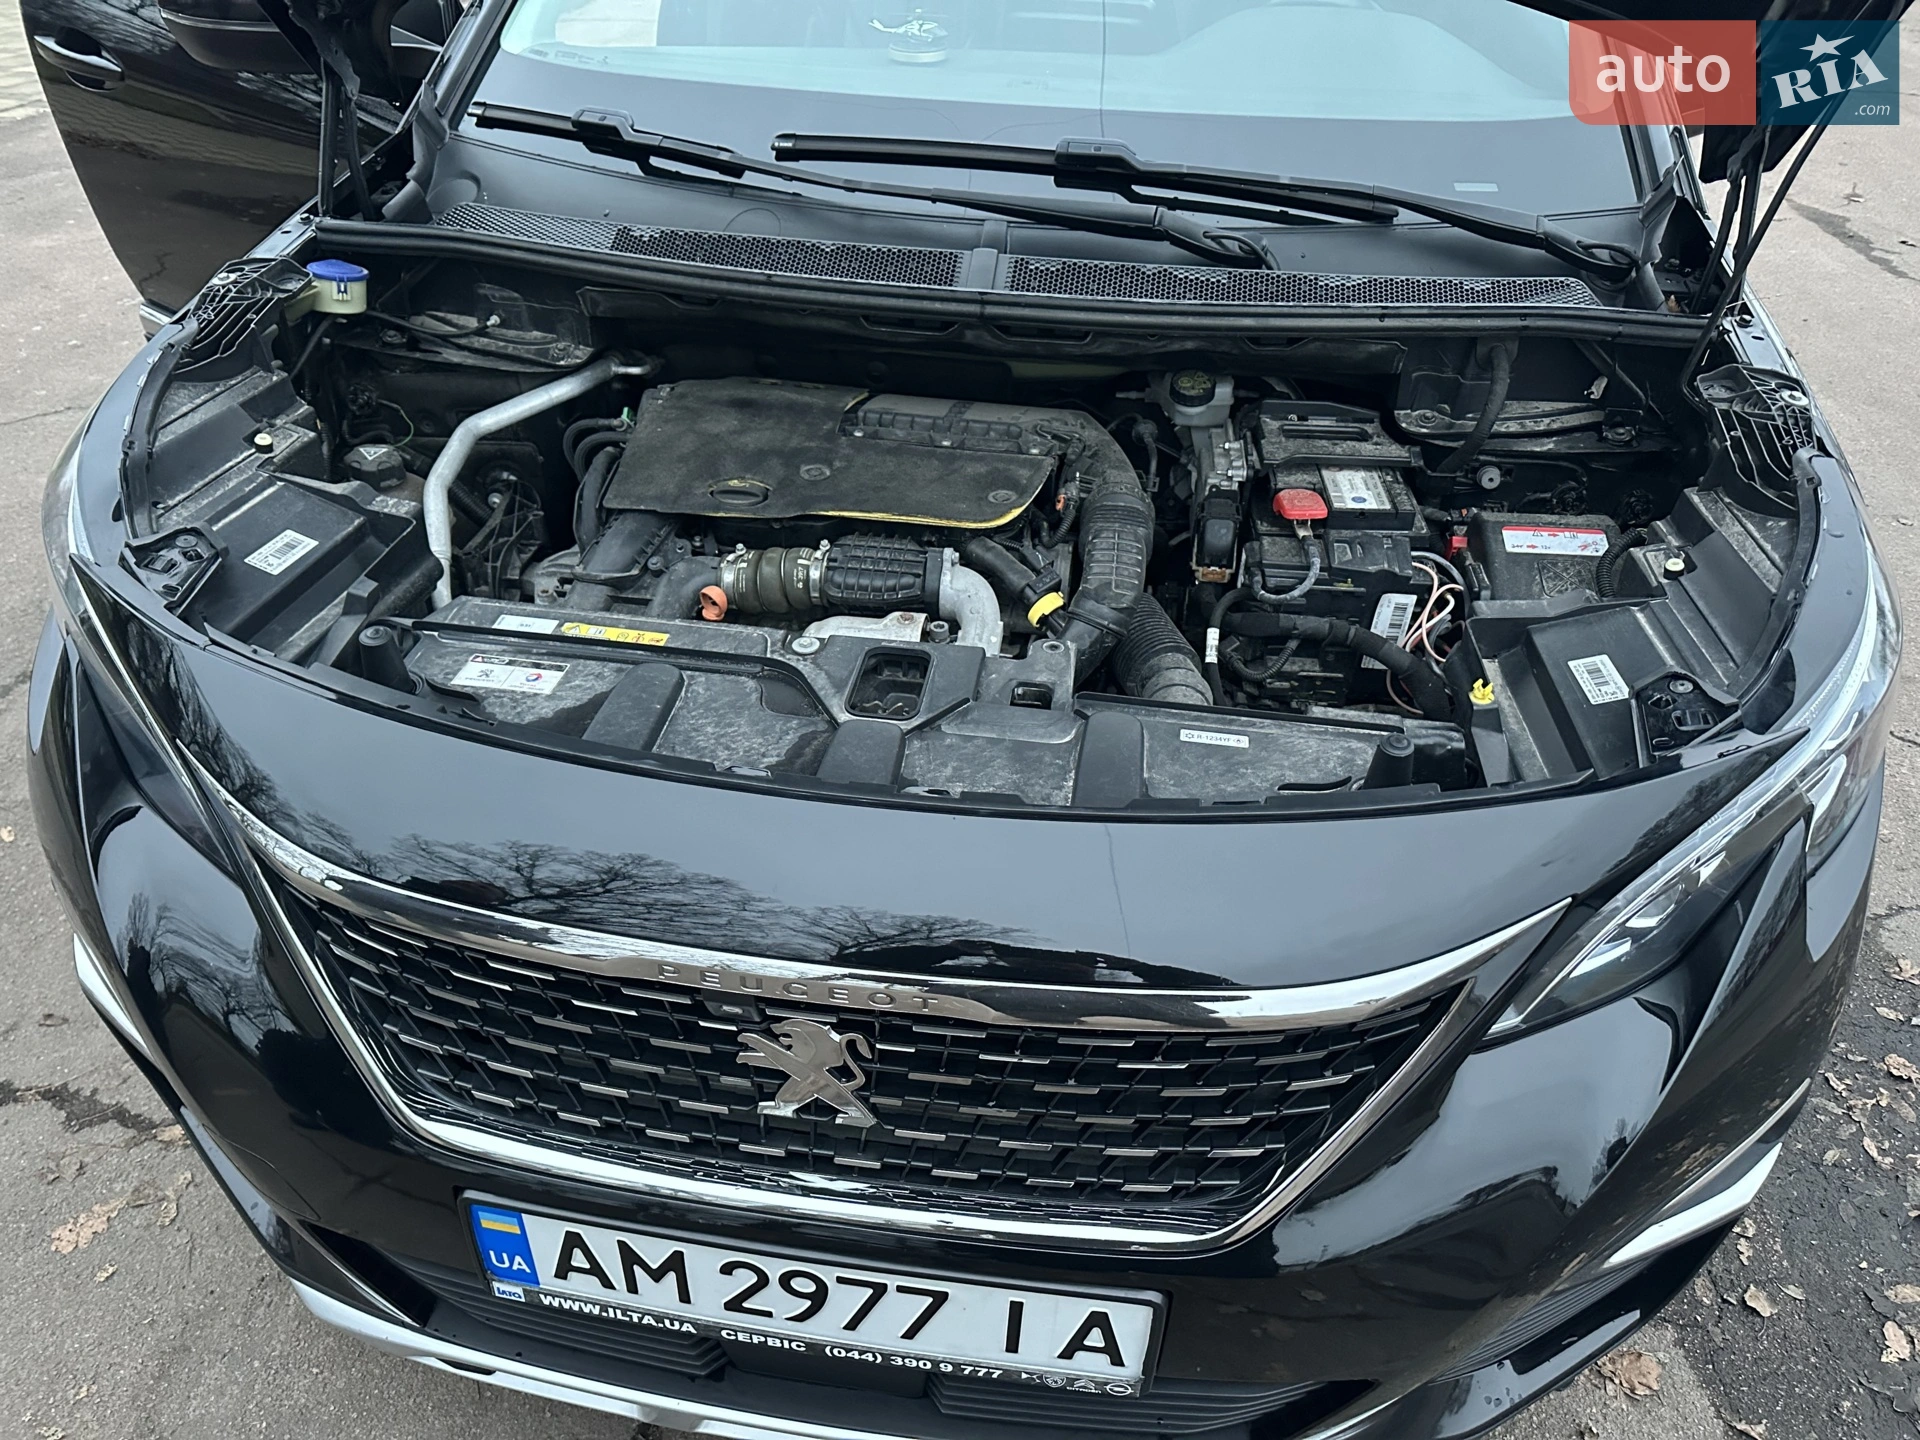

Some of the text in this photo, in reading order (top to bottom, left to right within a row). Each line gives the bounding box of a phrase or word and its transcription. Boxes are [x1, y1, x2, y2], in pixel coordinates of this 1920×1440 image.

[657, 963, 938, 1012] PEUGEOT
[489, 1249, 532, 1273] UA
[538, 1293, 698, 1334] WWW.ILTA.UA
[553, 1230, 1126, 1367] AM 2977 IA
[824, 1345, 1003, 1379] (044) 390 9 777
